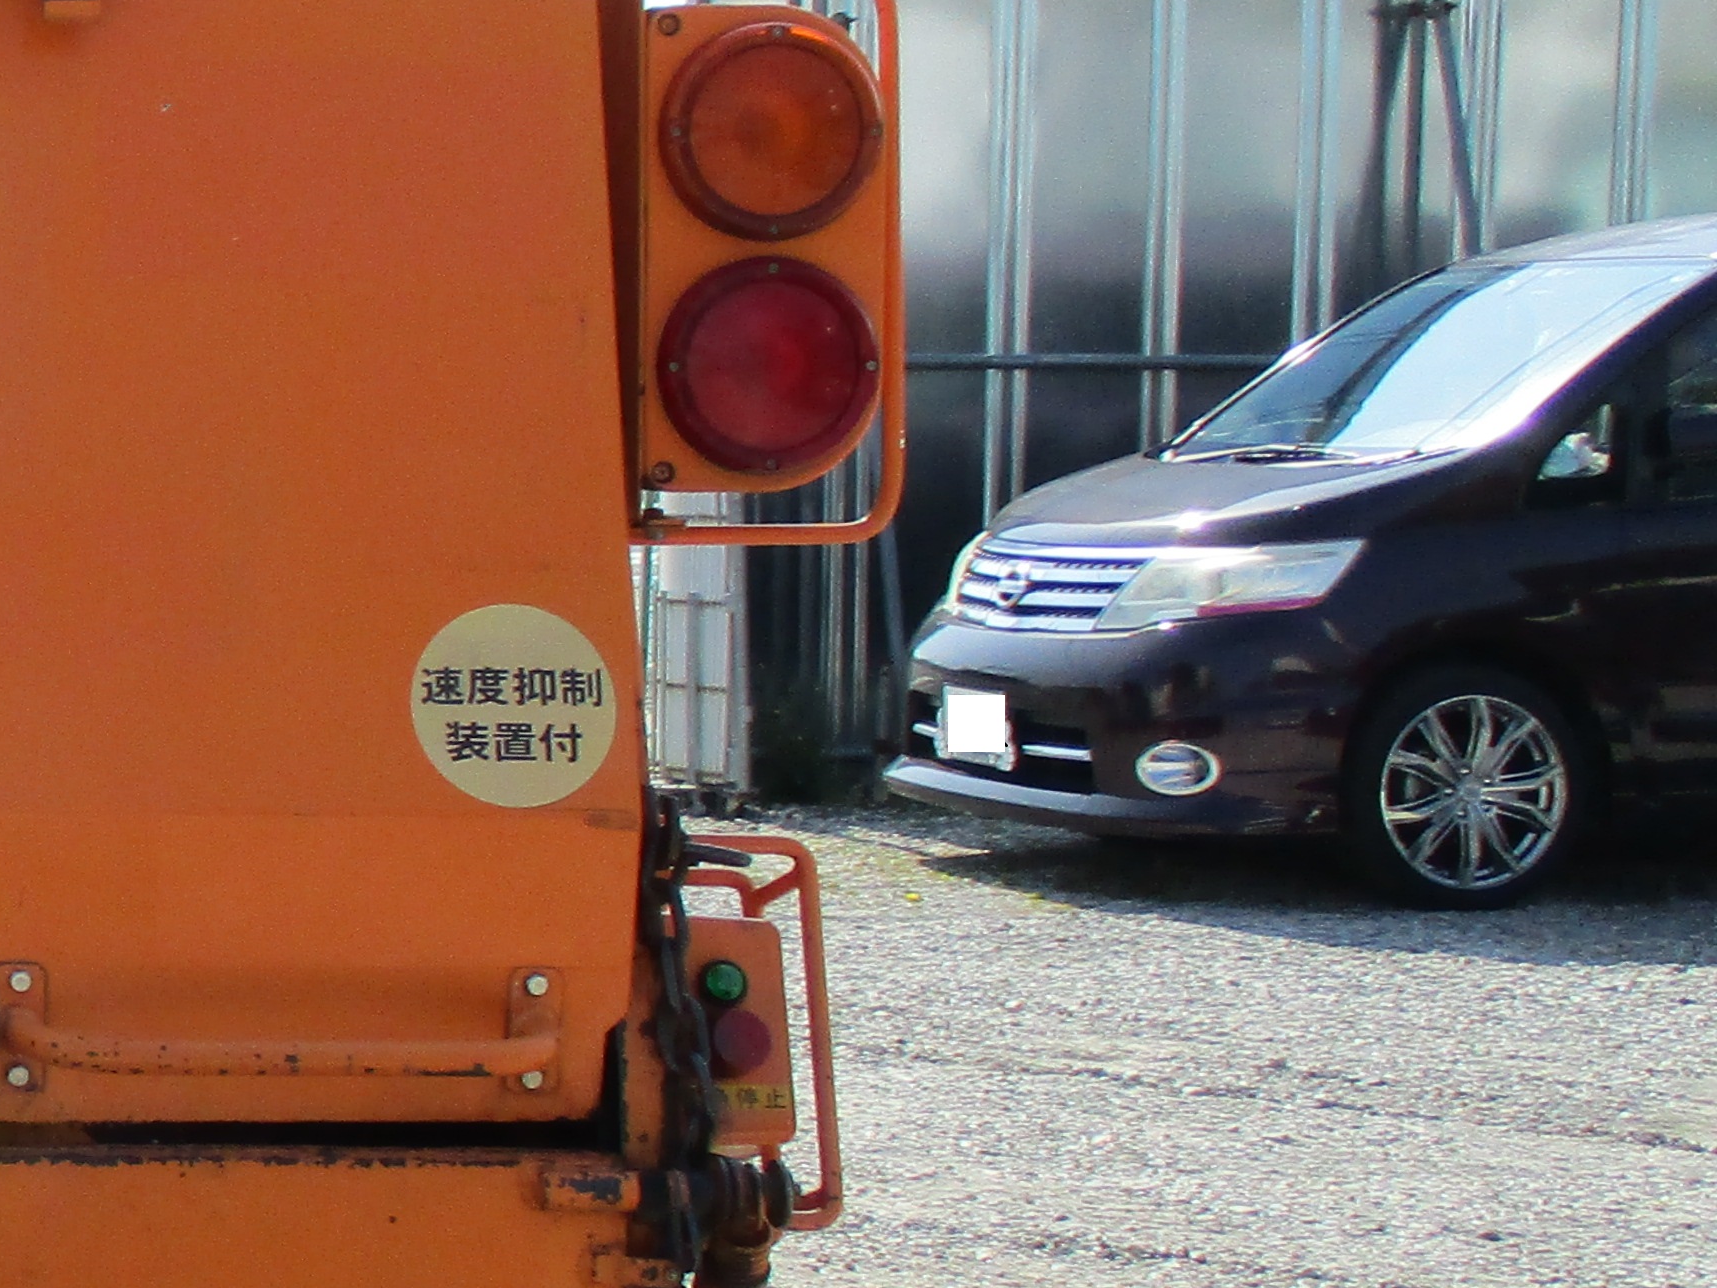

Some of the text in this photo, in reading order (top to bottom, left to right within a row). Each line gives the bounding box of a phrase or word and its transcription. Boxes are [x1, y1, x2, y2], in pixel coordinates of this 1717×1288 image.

[420, 665, 603, 707] 速度抑制
[444, 721, 583, 763] 装置付
